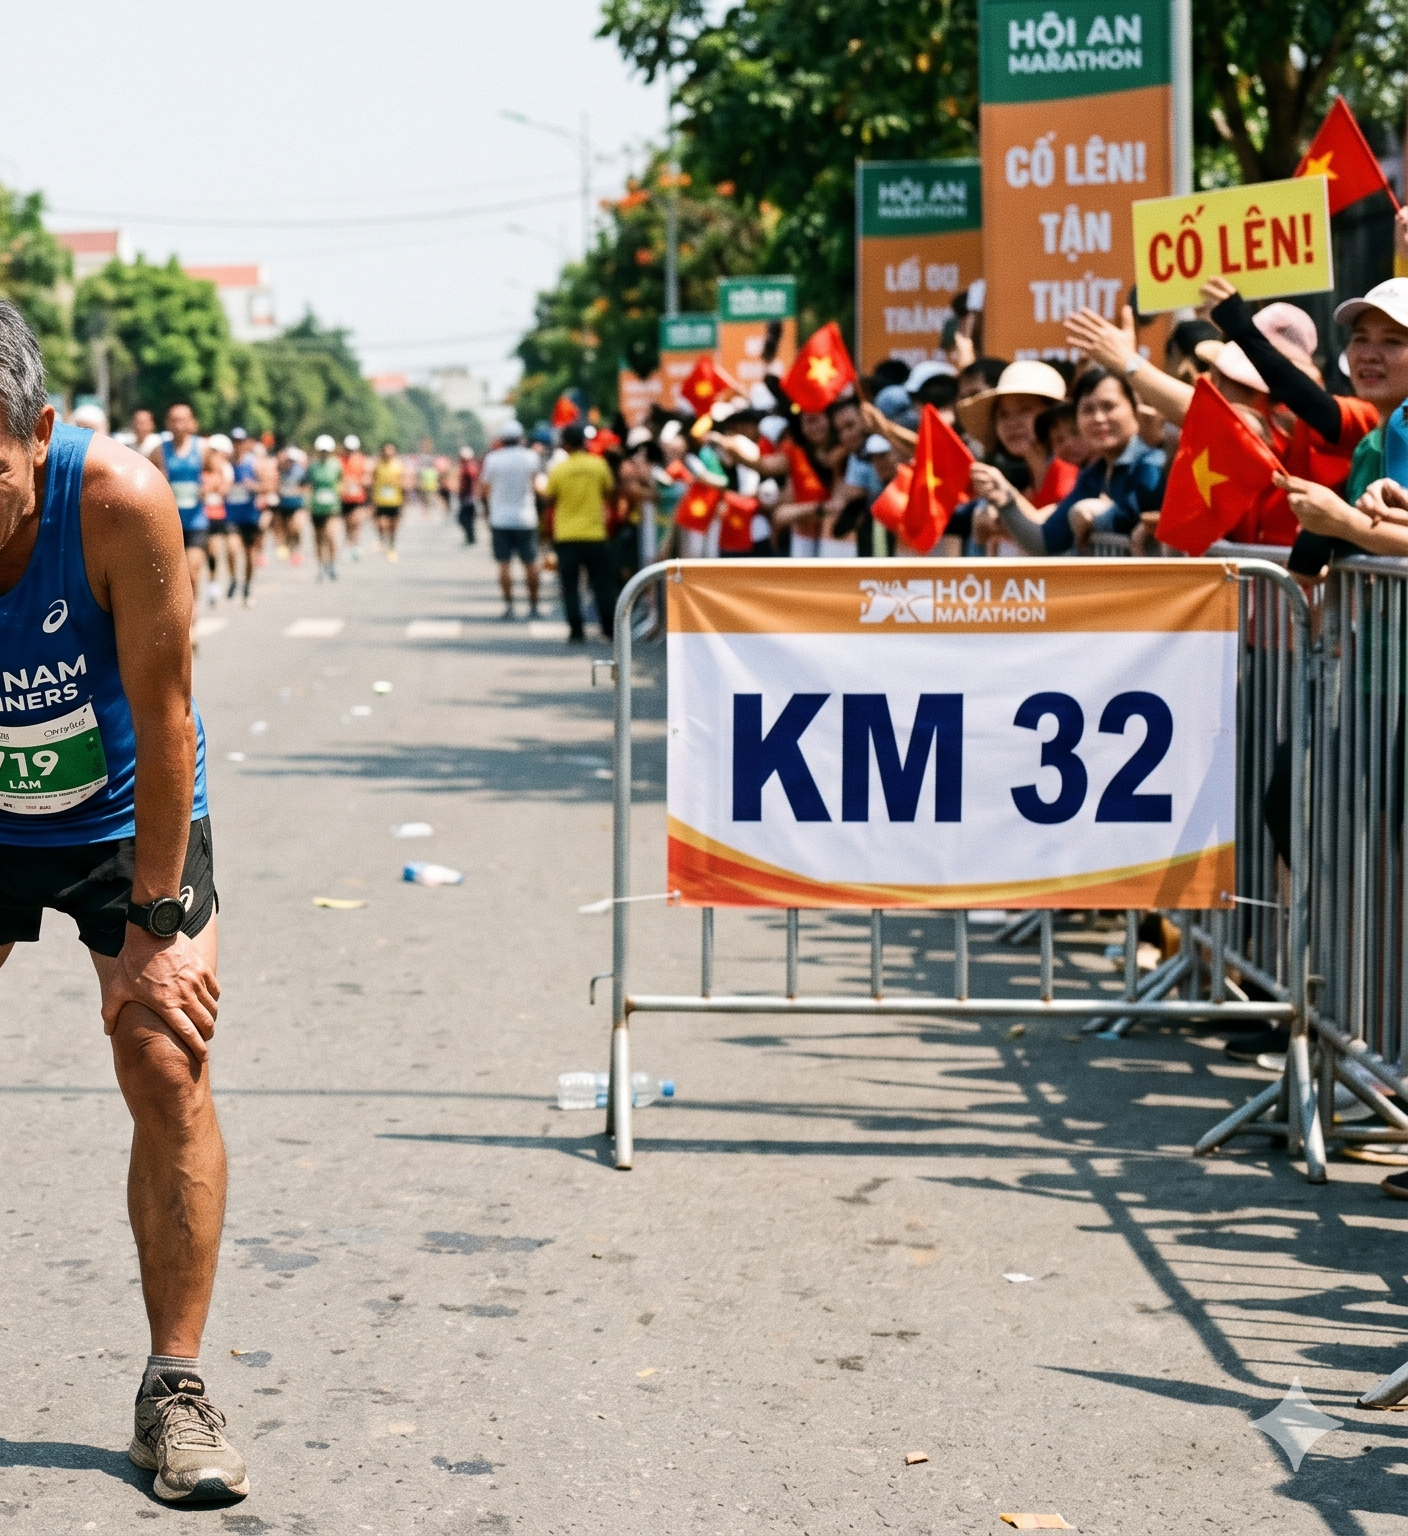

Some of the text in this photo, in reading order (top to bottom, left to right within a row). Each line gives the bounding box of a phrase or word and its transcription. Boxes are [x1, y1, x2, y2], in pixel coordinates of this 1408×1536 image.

[1008, 11, 1142, 52] HỘI AN
[1008, 47, 1142, 75] MARATHON
[1005, 131, 1147, 188] CỐ LÊN!
[928, 180, 967, 202] AN
[1039, 204, 1112, 263] TẬN
[1149, 204, 1314, 283] CỐ LÊN!
[935, 574, 1046, 606] HỘI AN
[935, 606, 1046, 623] MARATHON
[732, 691, 1174, 825] KM 32
[9, 780, 41, 790] LAM
